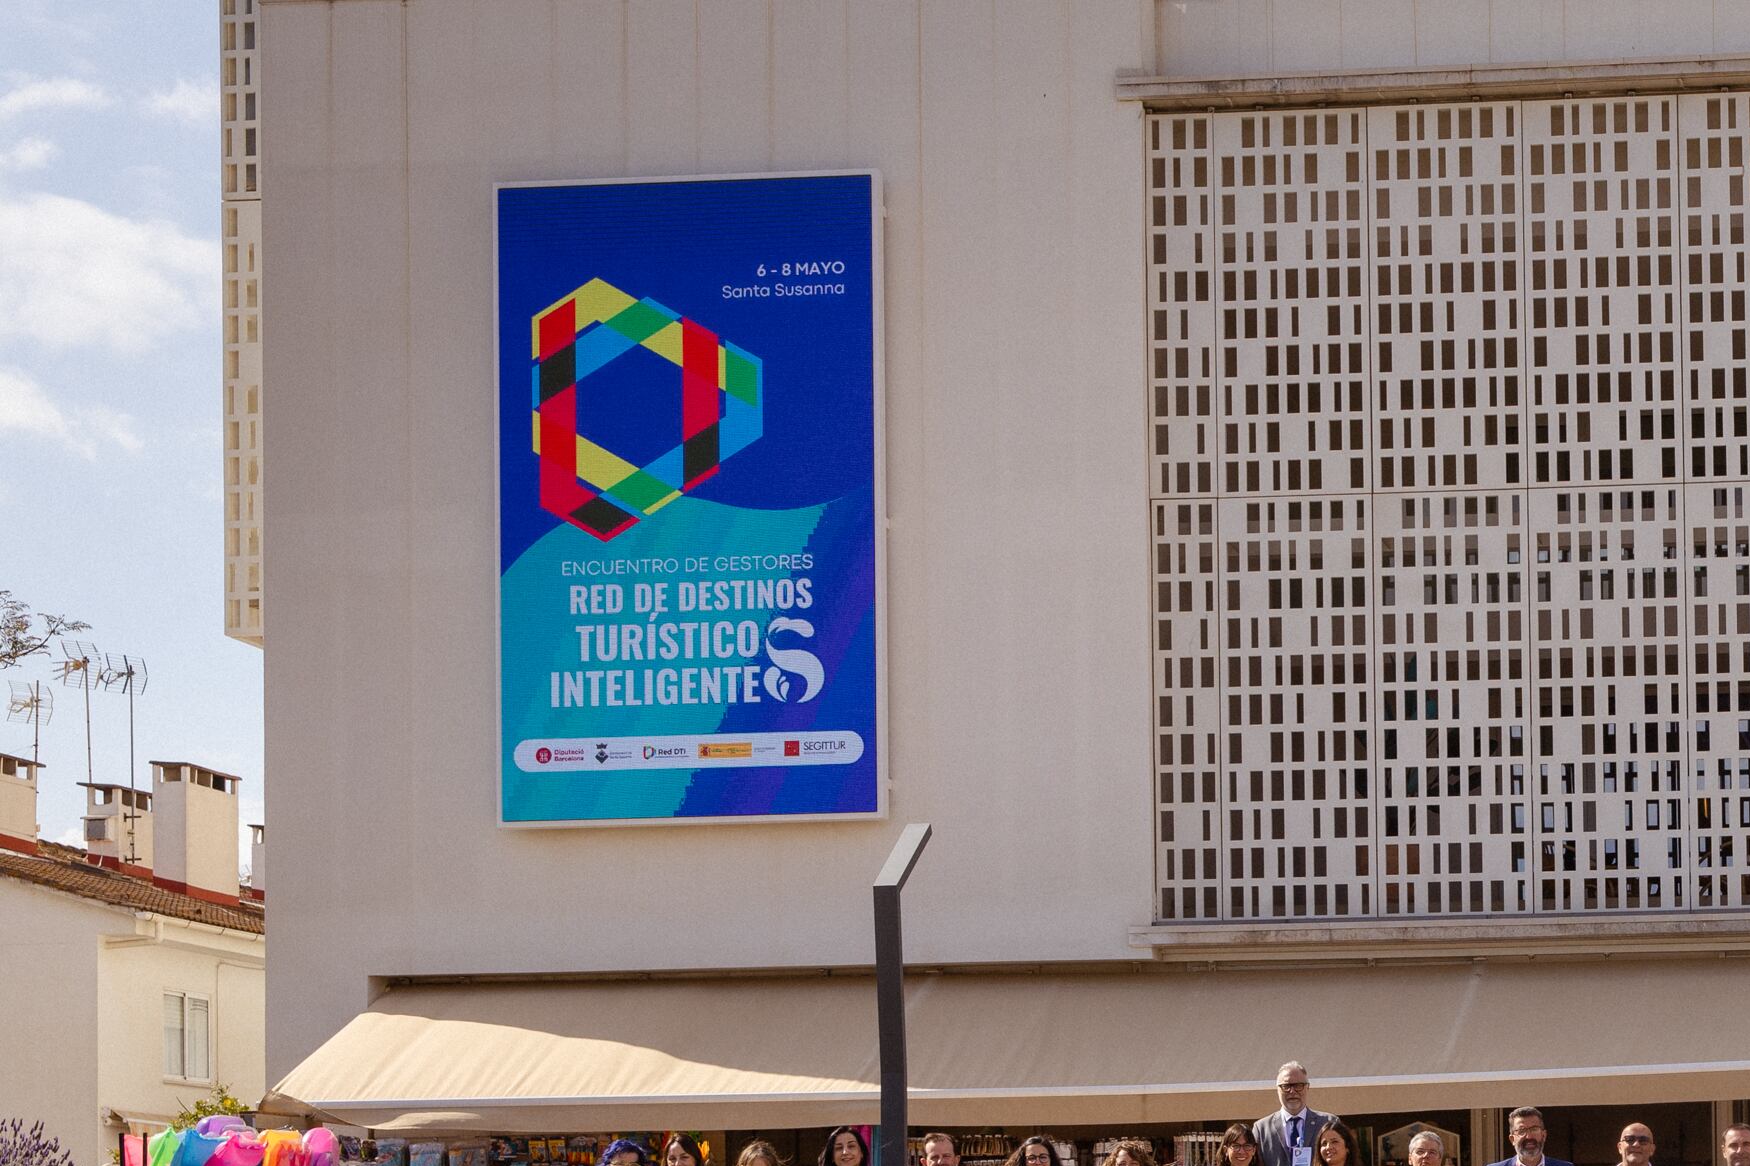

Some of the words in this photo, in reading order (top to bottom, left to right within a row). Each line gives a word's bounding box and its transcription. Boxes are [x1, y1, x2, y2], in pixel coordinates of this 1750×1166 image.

[756, 264, 767, 276] 6
[781, 263, 792, 276] 8
[795, 261, 845, 276] MAYO
[722, 284, 771, 298] Santa
[774, 283, 845, 297] Susanna
[561, 558, 679, 576] ENCUENTRO
[685, 557, 709, 573] DE
[713, 554, 814, 571] GESTORES
[569, 583, 624, 615] RED
[633, 582, 669, 613] DE
[678, 577, 814, 612] DESTINOS
[554, 748, 585, 757] Diputació
[658, 748, 672, 756] Red
[673, 747, 687, 755] DTI
[803, 740, 846, 751] SEGITTUR
